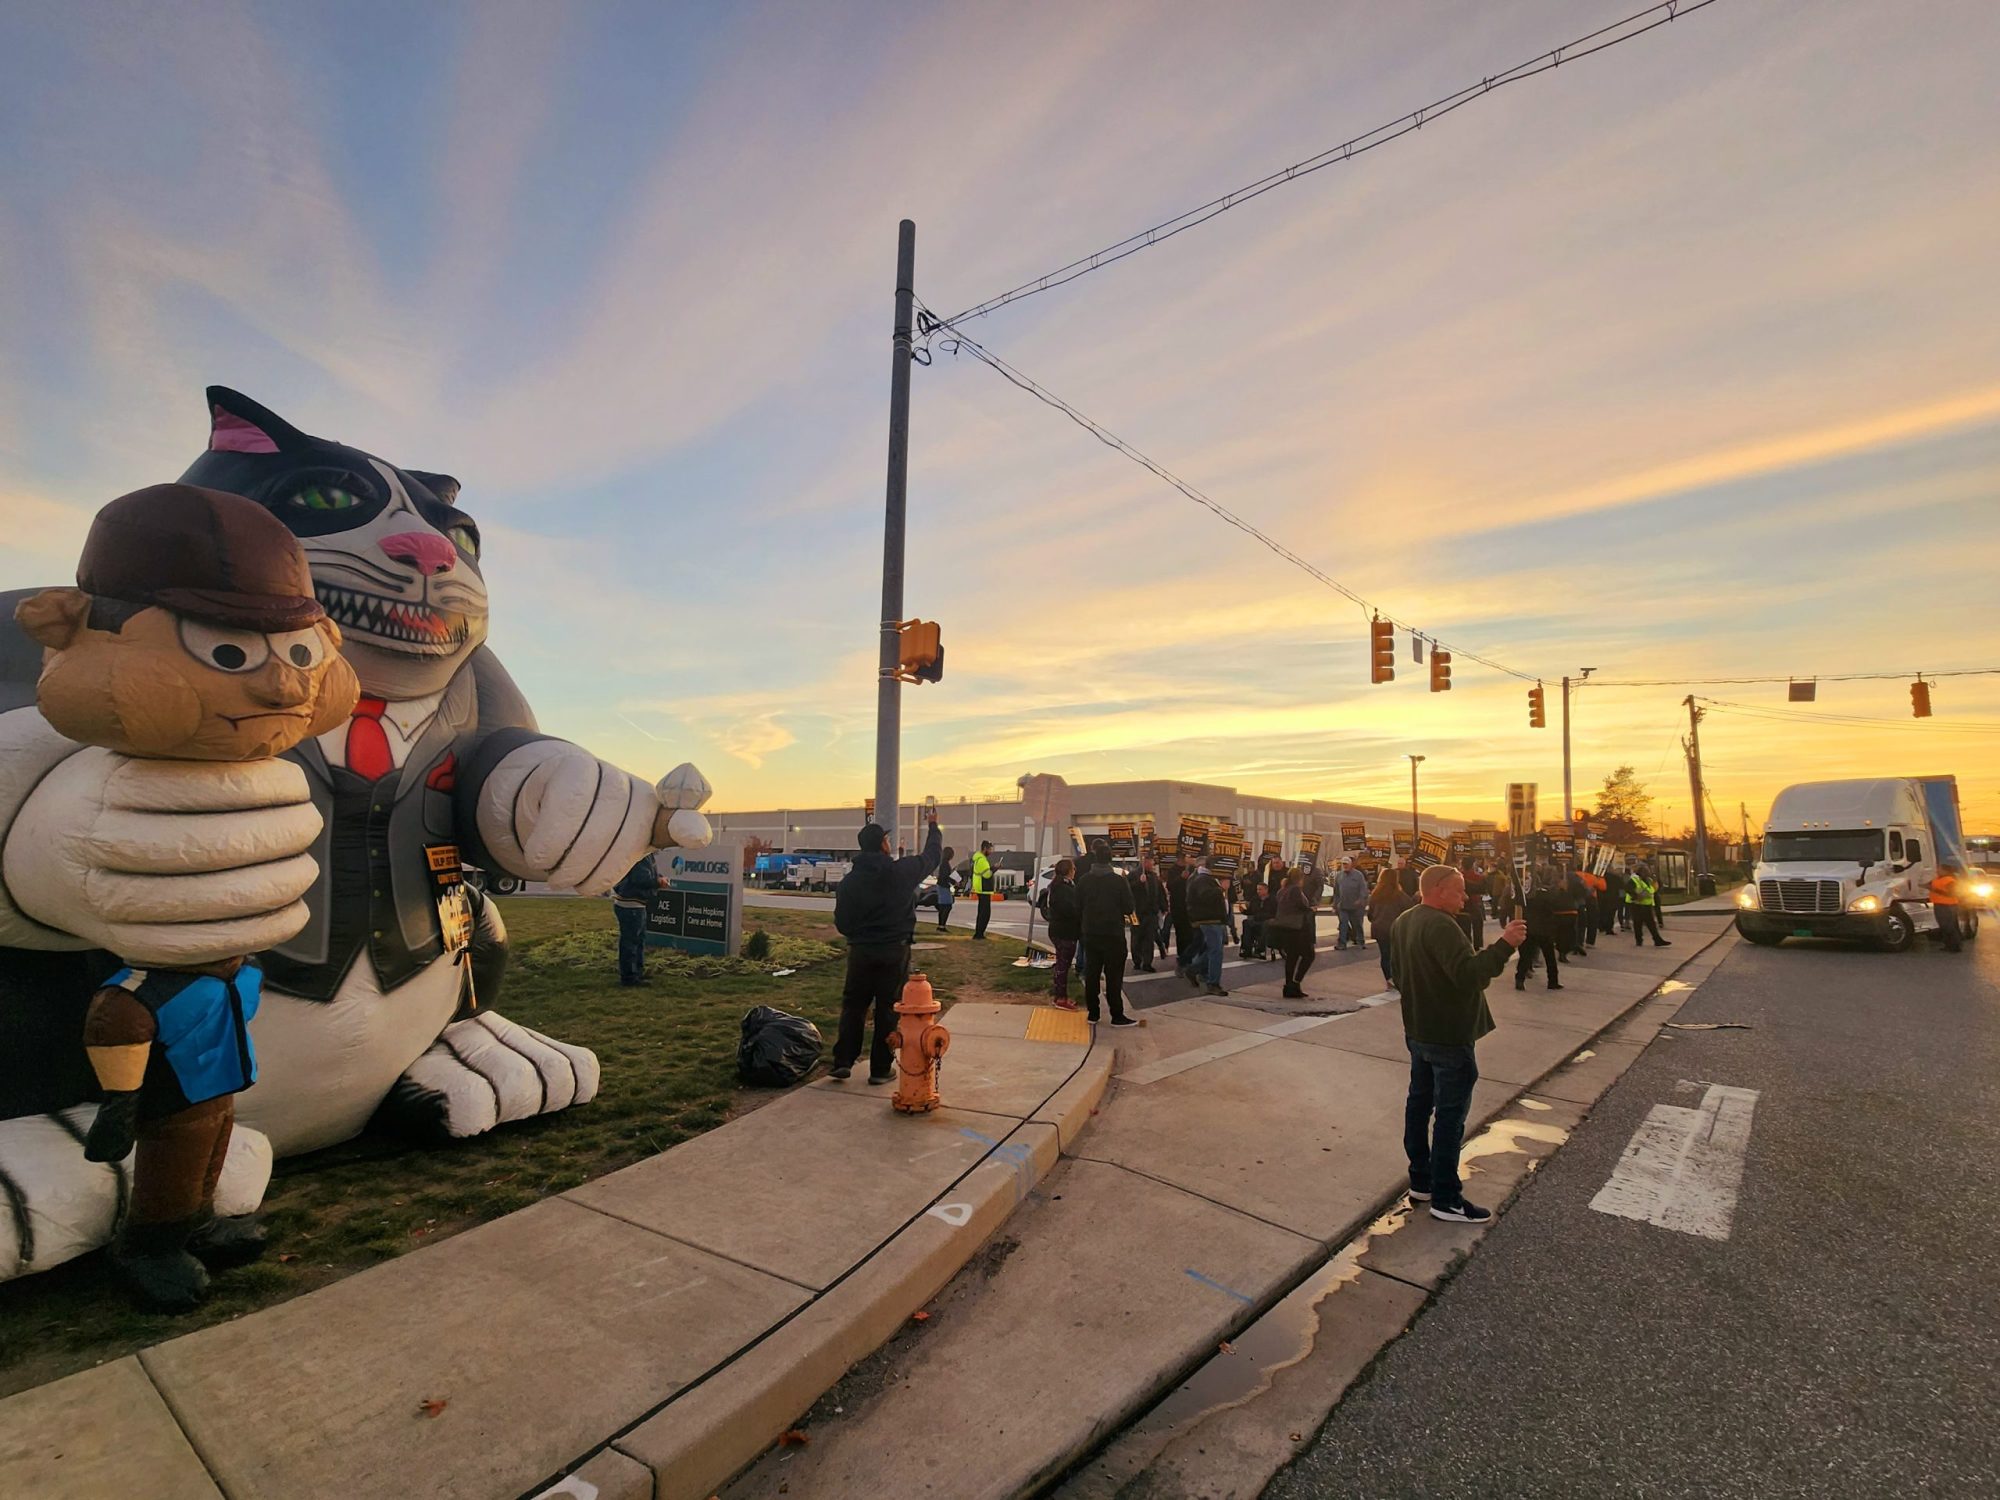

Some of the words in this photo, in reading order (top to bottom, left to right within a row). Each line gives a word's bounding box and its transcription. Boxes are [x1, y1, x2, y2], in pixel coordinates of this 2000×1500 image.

[684, 860, 729, 874] PROLOGIS
[658, 900, 670, 910] ACE
[687, 905, 702, 914] Johns
[703, 906, 725, 917] Hopkins
[651, 913, 676, 925] Logistics
[688, 916, 699, 925] Care
[707, 919, 722, 928] Home
